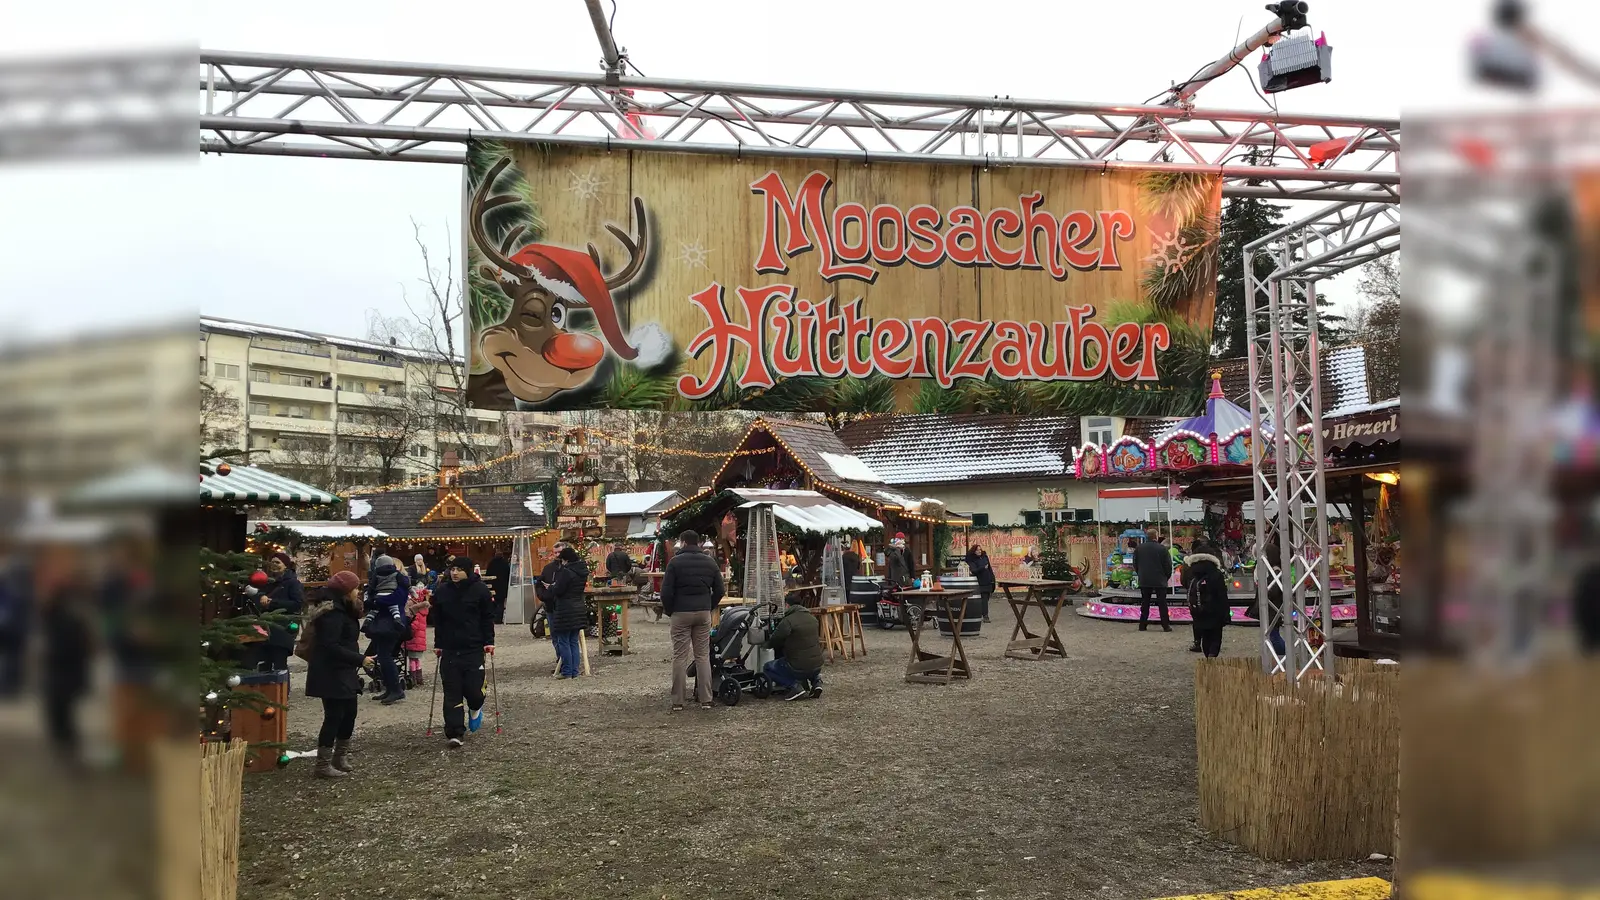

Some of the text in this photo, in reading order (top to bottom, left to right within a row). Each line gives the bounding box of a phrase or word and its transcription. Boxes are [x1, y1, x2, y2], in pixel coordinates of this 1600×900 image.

[749, 169, 1135, 283] Moosacher
[677, 281, 1170, 400] Hüttenzauber
[1333, 414, 1397, 440] Herzerl
